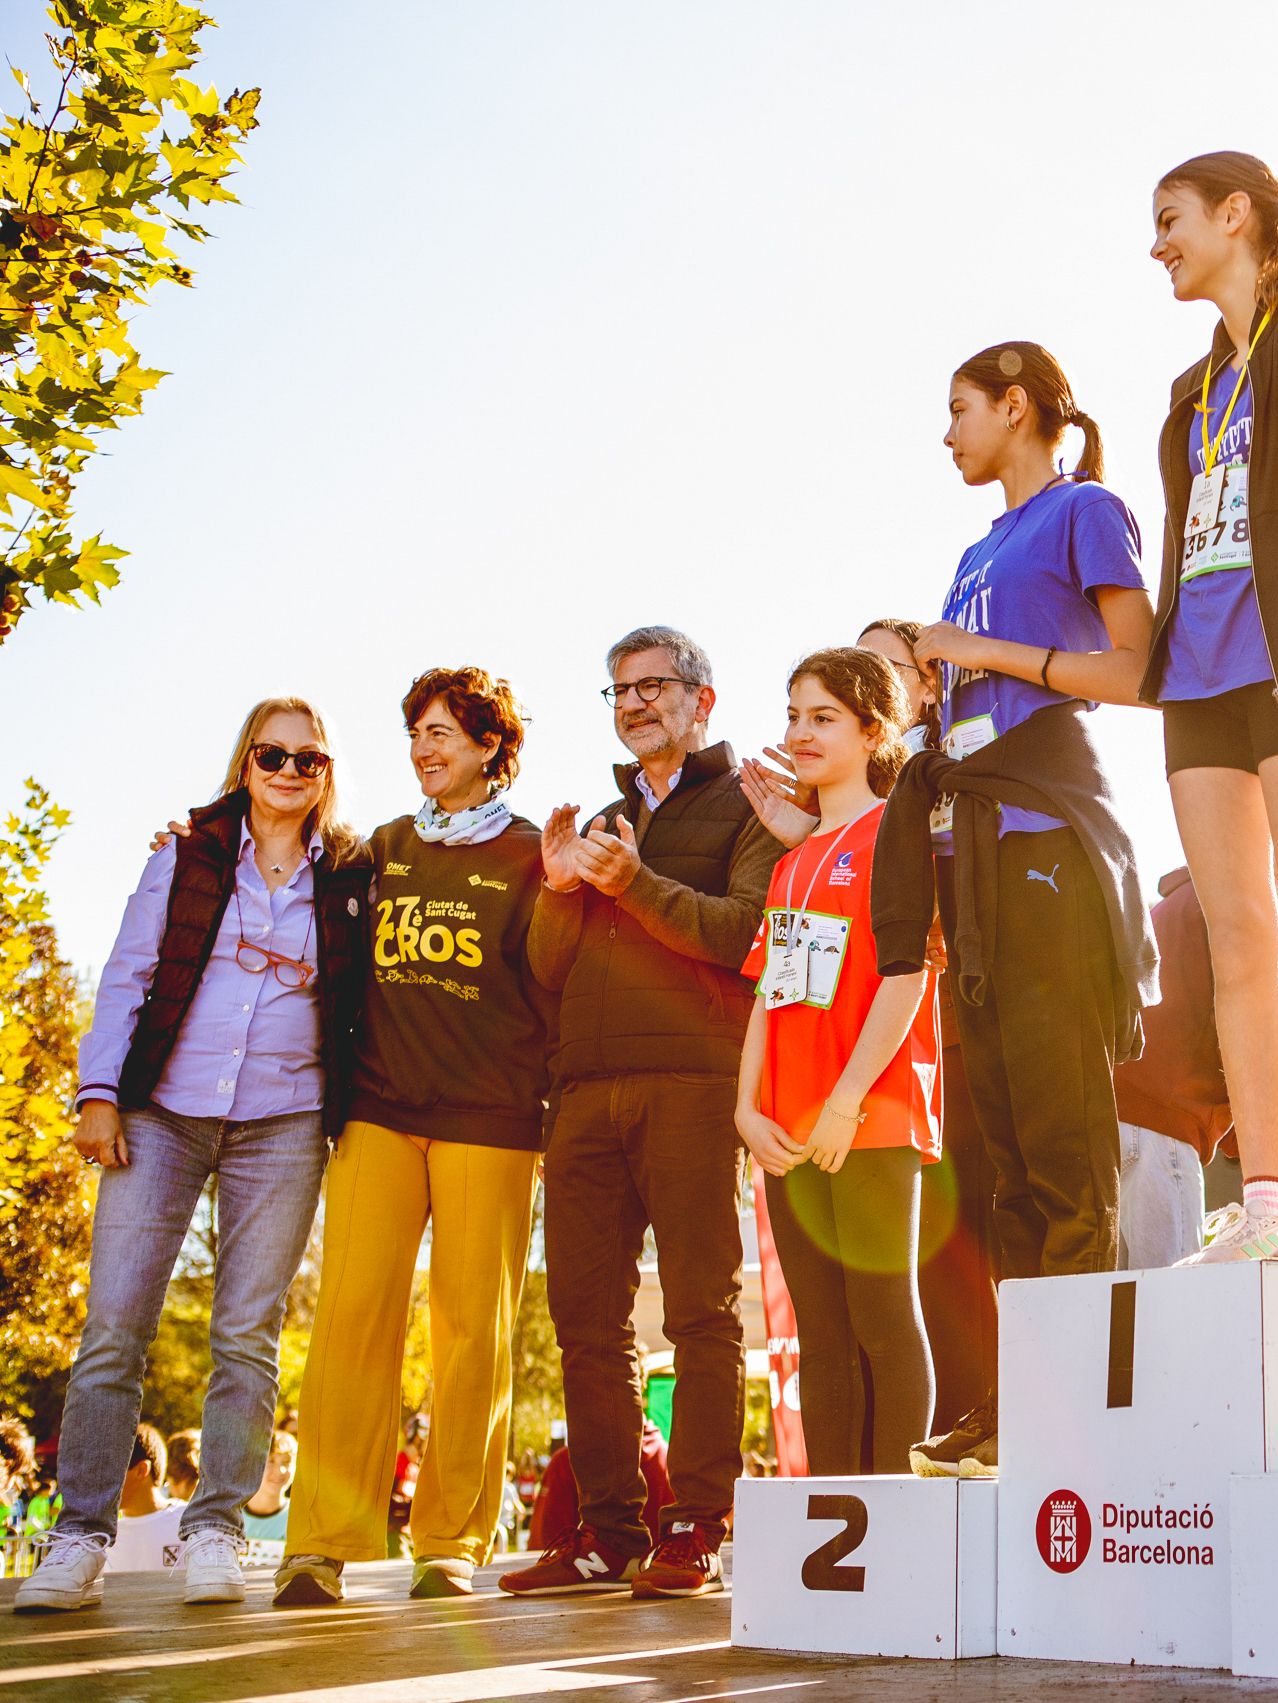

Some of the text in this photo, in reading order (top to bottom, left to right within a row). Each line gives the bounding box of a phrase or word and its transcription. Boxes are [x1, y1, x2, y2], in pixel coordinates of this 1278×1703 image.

[425, 908, 477, 920] Sant Cugat
[426, 900, 469, 911] Ciutat de
[375, 924, 483, 968] CROS
[1103, 1503, 1214, 1534] Diputació
[800, 1494, 869, 1593] 2
[1103, 1538, 1214, 1565] Barcelona
